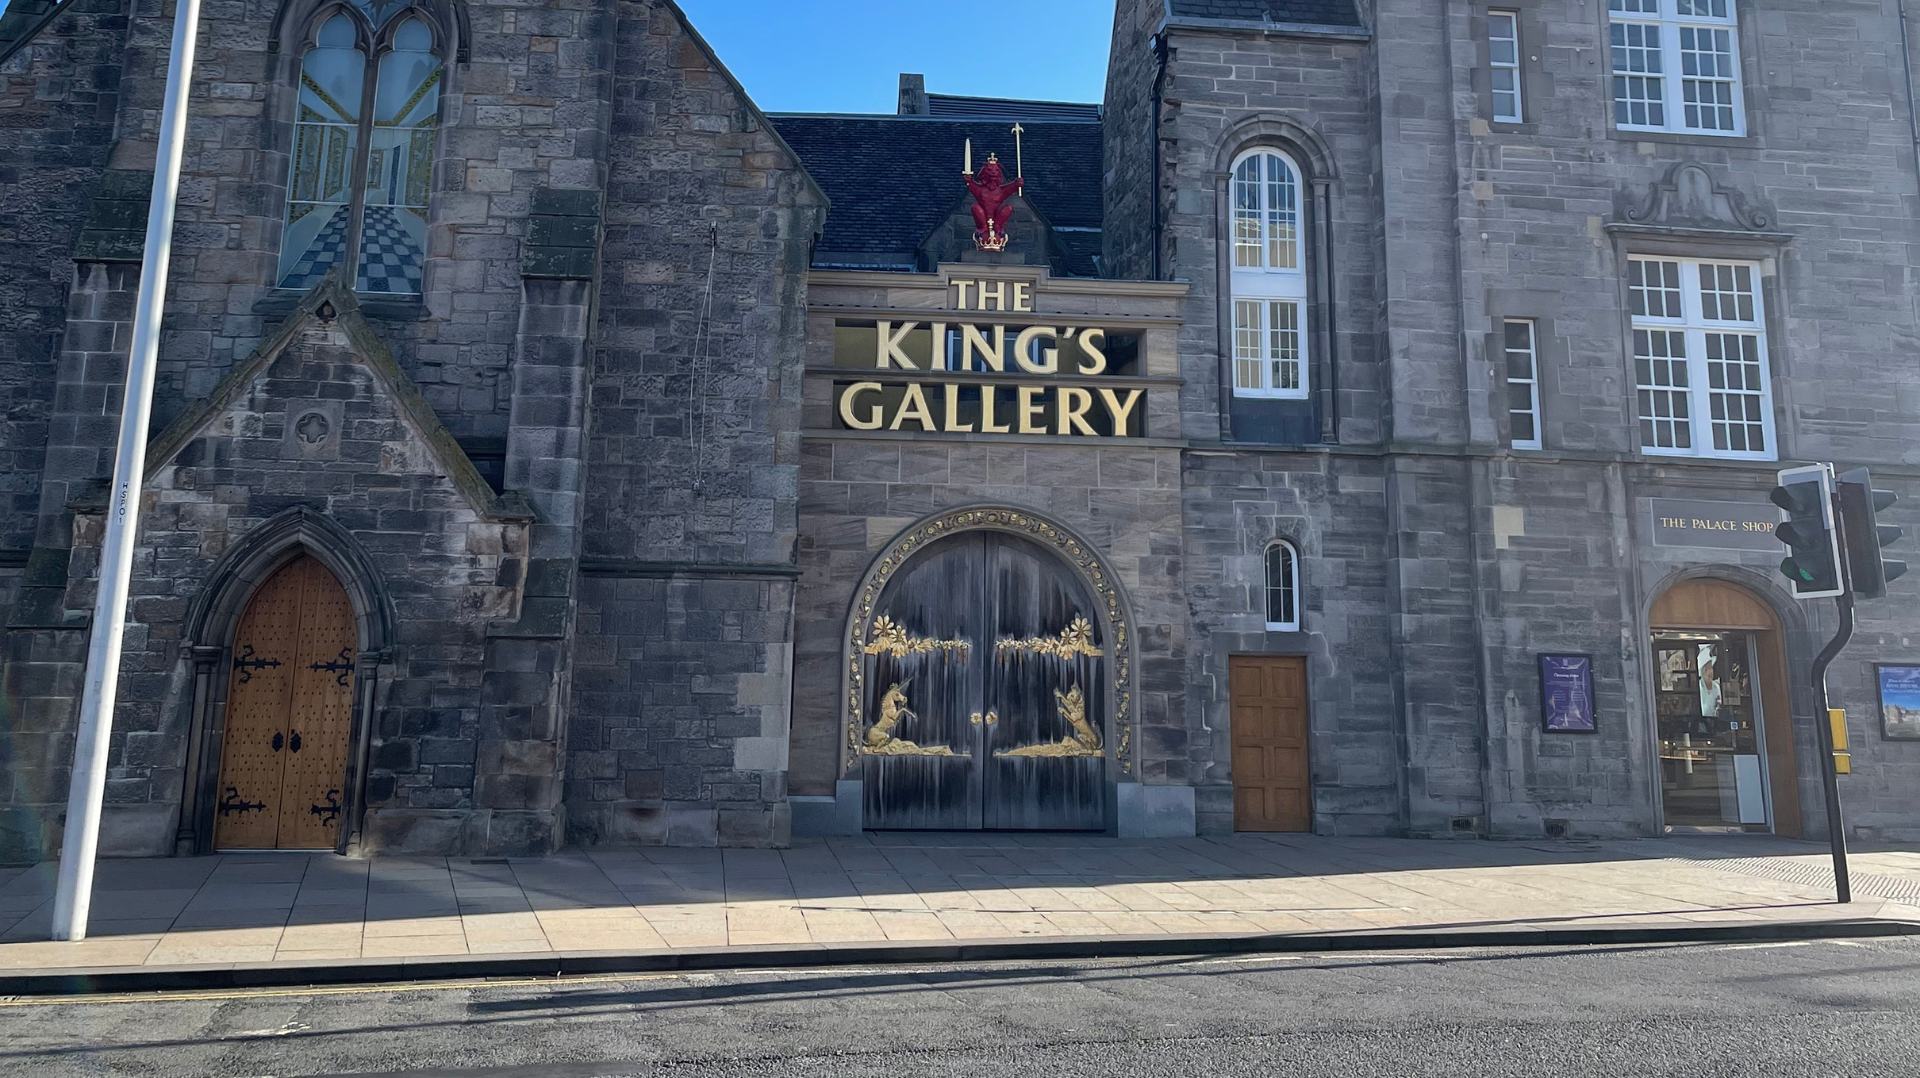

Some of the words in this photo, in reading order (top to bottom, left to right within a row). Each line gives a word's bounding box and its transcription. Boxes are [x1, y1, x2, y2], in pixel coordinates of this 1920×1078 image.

[950, 280, 1032, 312] THE
[875, 320, 1108, 375] KING'S
[838, 382, 1145, 437] GALLERY
[1660, 517, 1687, 529] THE
[1691, 518, 1737, 531] PALACE
[1742, 521, 1774, 533] SHOP
